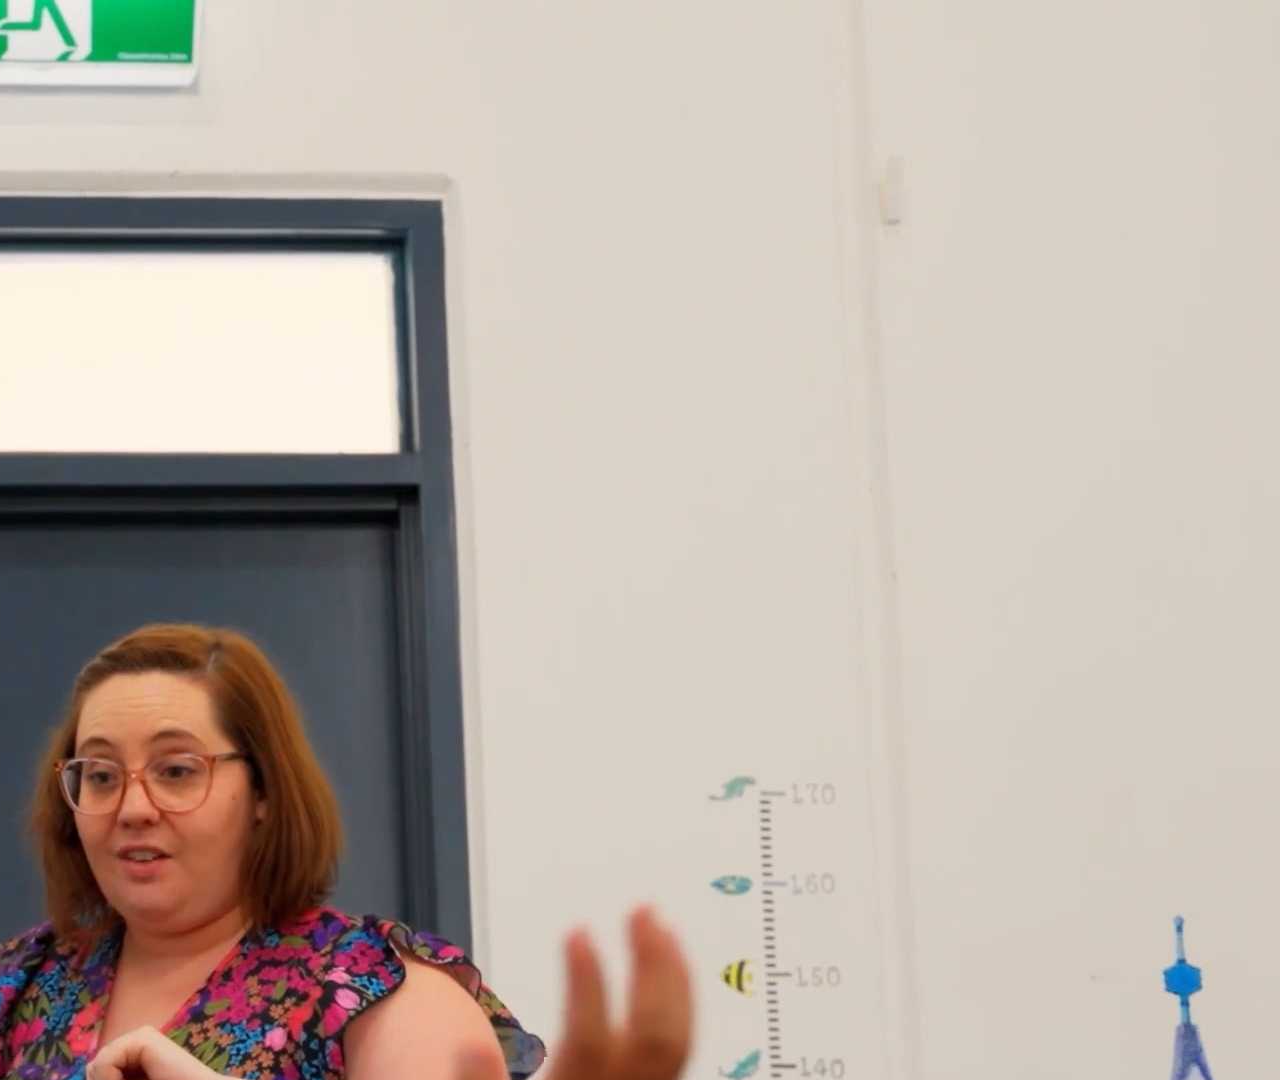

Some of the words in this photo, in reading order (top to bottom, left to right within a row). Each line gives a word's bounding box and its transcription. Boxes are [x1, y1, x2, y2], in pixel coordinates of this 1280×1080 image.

[791, 874, 835, 895] 160
[796, 966, 841, 987] 150
[799, 1057, 845, 1079] 140
